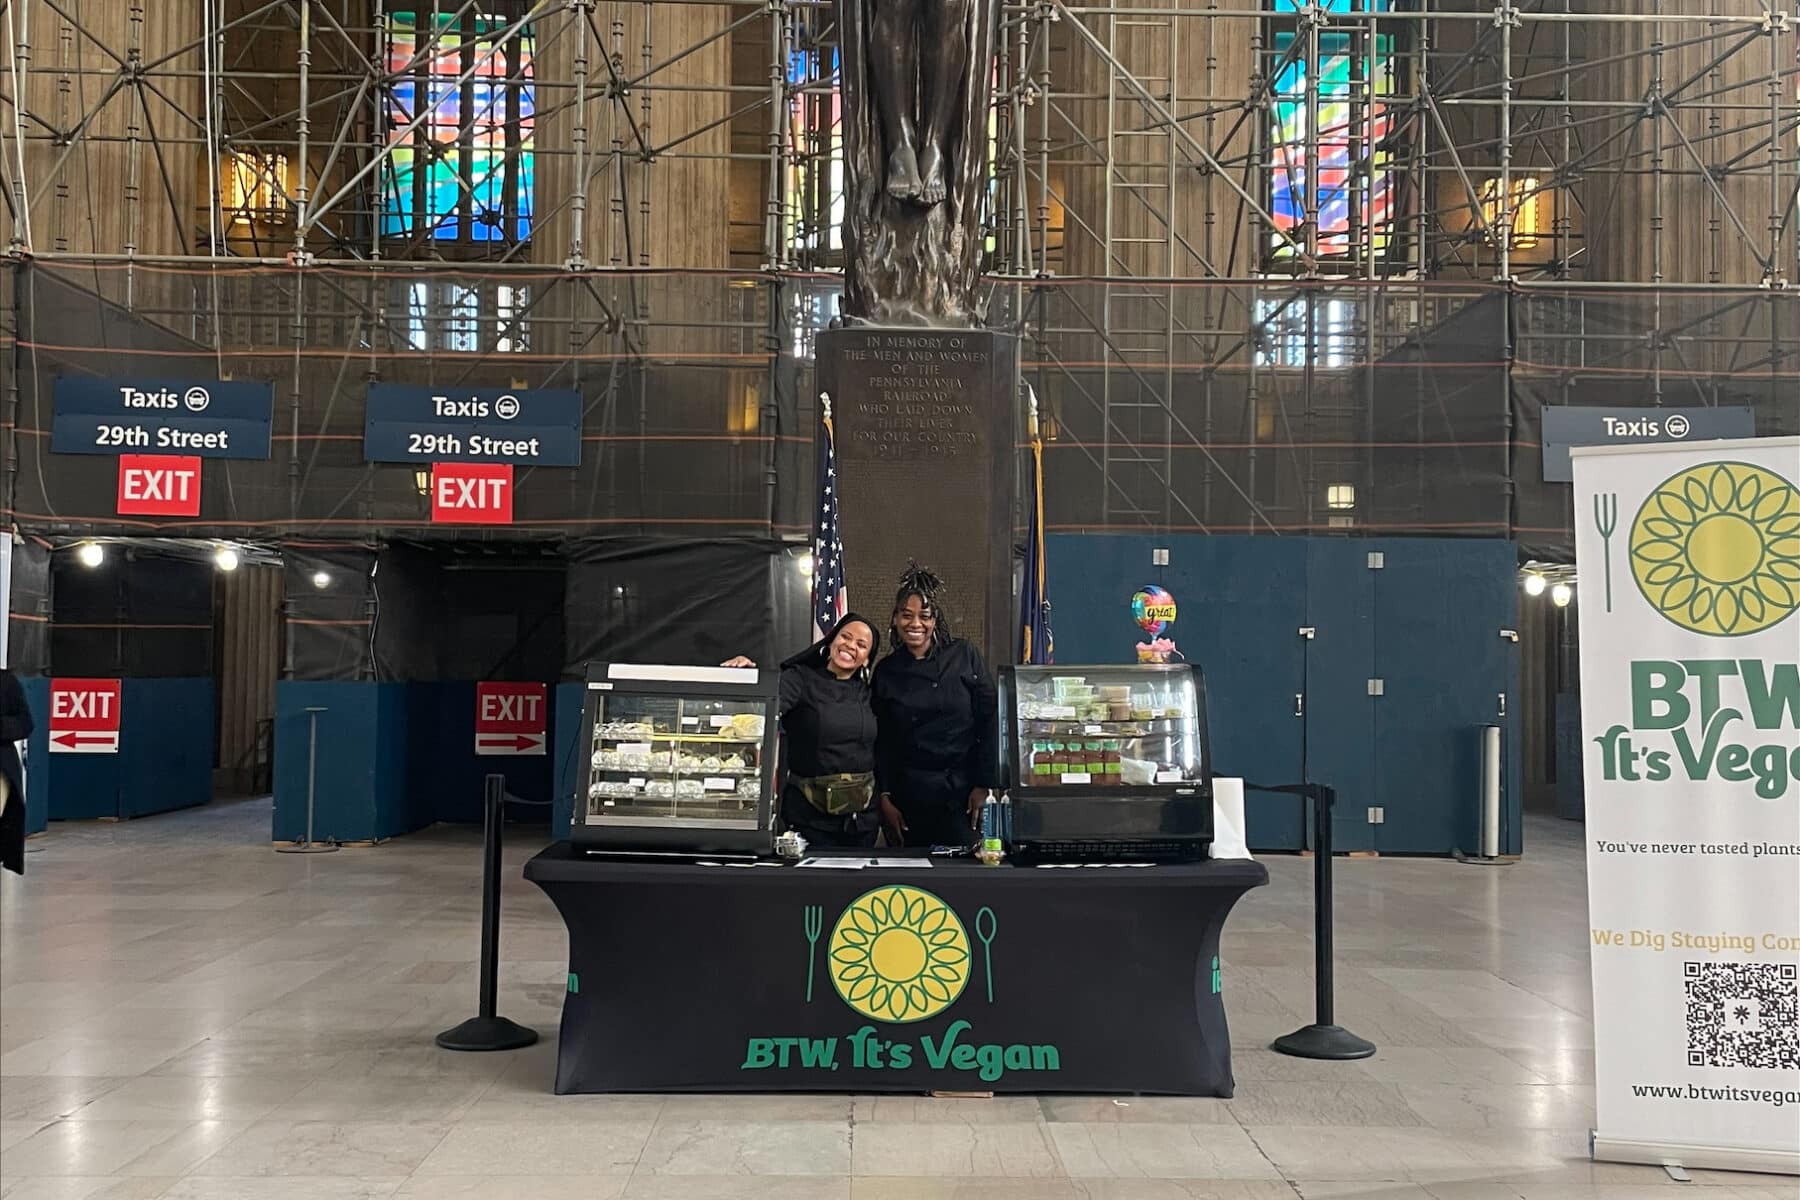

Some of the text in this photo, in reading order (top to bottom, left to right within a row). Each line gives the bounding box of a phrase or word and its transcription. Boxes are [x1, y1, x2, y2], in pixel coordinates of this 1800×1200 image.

[866, 336, 968, 348] IN MEMORY OF
[844, 350, 988, 362] THE MEN AND WOMEN
[891, 364, 942, 375] OF THE
[869, 377, 964, 388] PENNSYLVANIA
[120, 388, 178, 409] Taxis
[431, 396, 489, 418] Taxis
[884, 391, 948, 401] RAILROAD
[859, 404, 974, 415] WHO LAID DOWN
[95, 425, 228, 450] 29th Street
[1603, 417, 1660, 437] Taxis
[407, 433, 540, 457] 29th Street
[123, 470, 195, 501] EXIT
[438, 477, 507, 509] EXIT
[52, 691, 115, 719] EXIT
[481, 694, 542, 722] EXIT
[1593, 707, 1800, 800] It's Veg
[1597, 840, 1647, 854] You've
[1651, 843, 1696, 855] never
[1700, 842, 1749, 855] tasted
[1592, 930, 1624, 946] We
[1629, 930, 1665, 952] Dig
[1671, 931, 1756, 953] Staying
[741, 1020, 1060, 1081] BTW, It's Vegan
